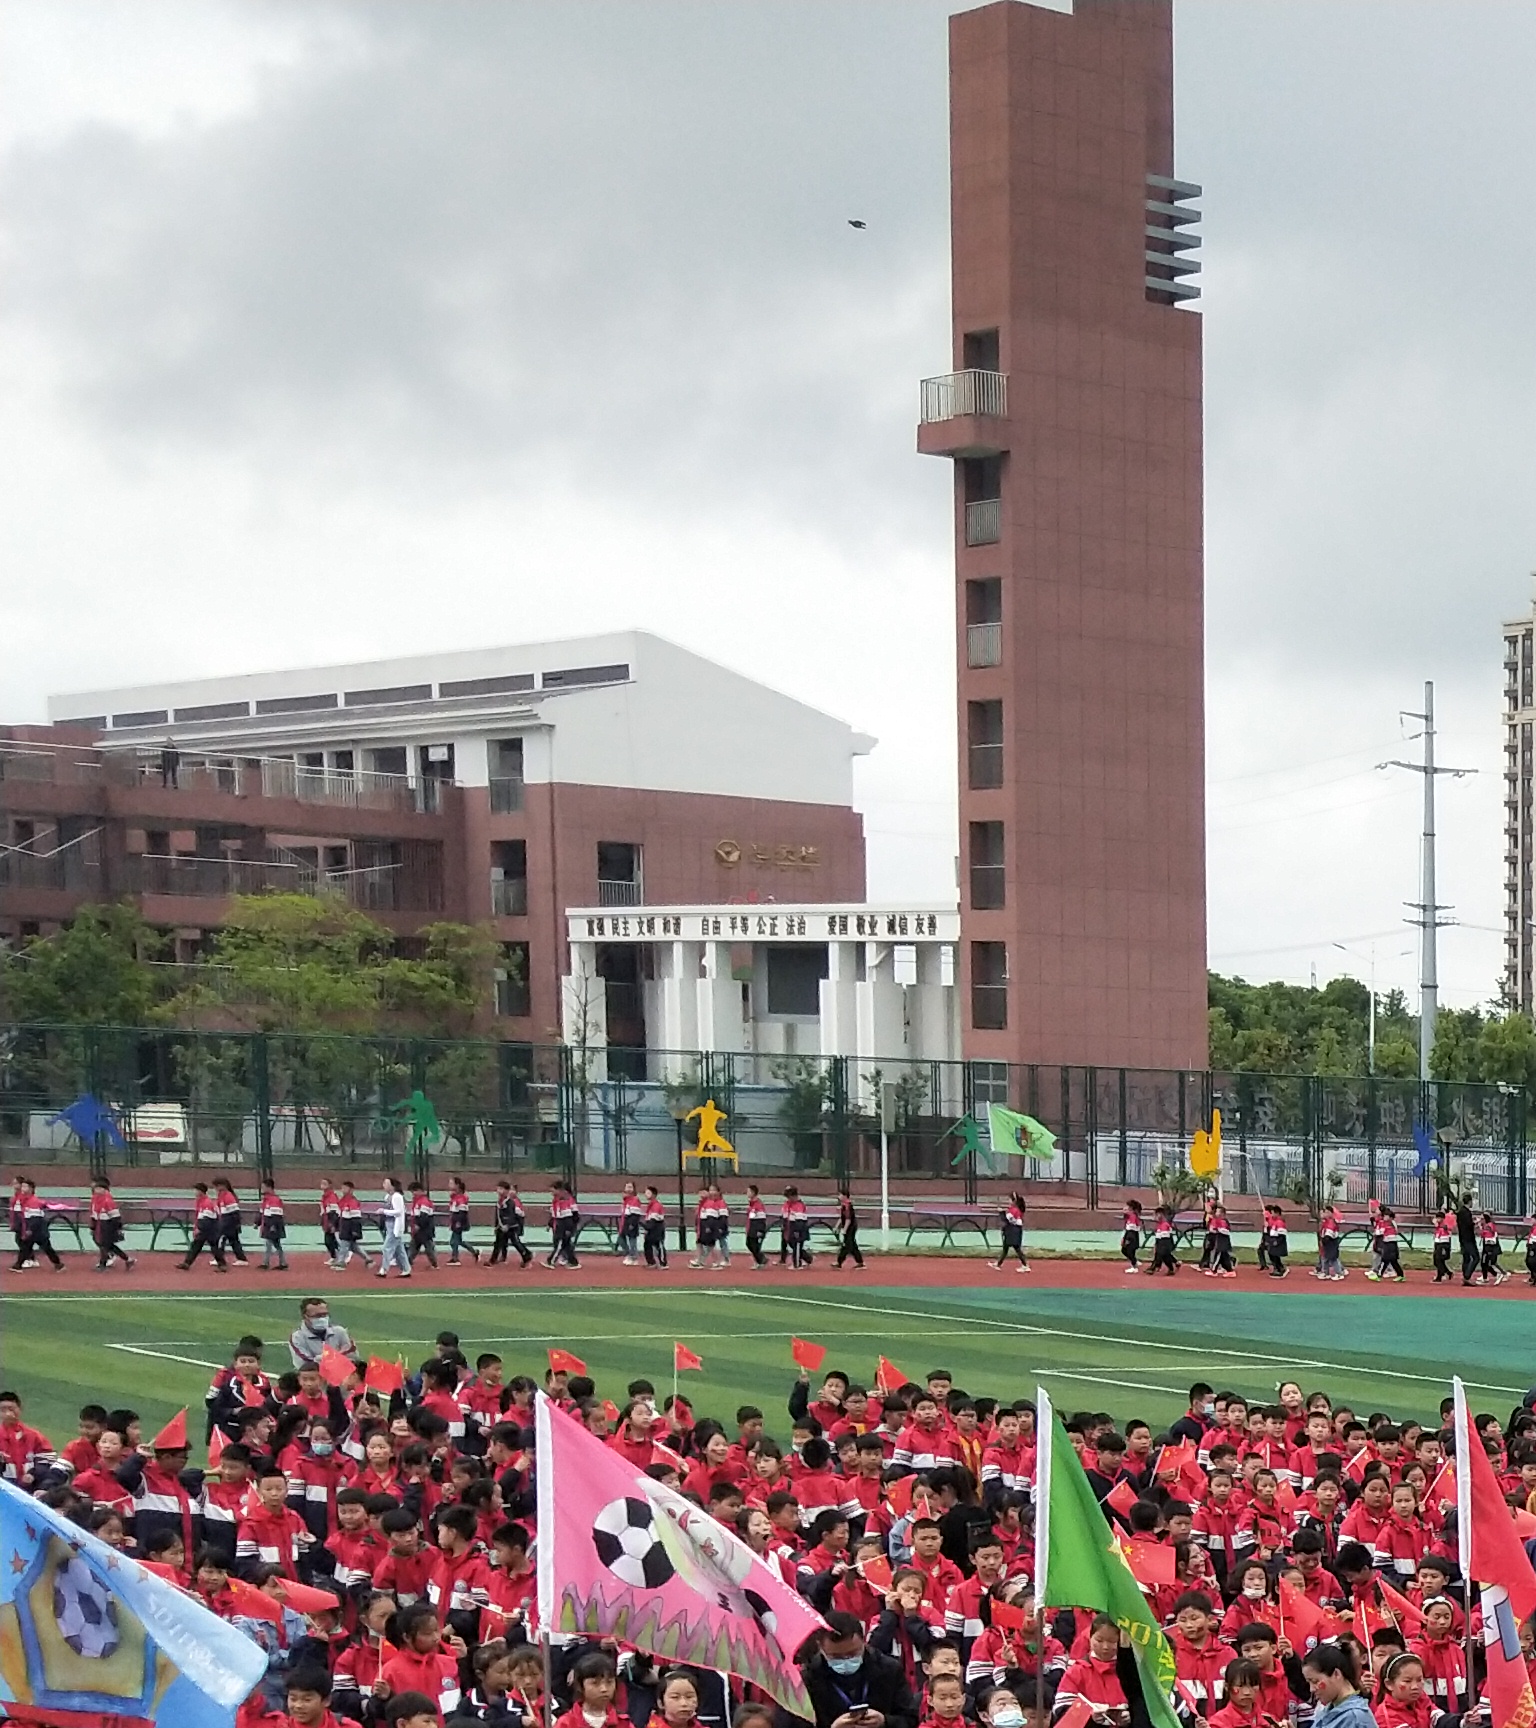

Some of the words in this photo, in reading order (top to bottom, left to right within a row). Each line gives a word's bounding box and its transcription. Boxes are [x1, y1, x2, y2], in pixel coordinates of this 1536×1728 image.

[586, 916, 606, 937] 富强
[611, 916, 631, 937] 民主
[636, 916, 656, 937] 文明
[662, 915, 682, 936] 和谐
[701, 915, 722, 936] 自由
[729, 915, 750, 935] 平等
[756, 915, 779, 936] 公正
[785, 915, 807, 936] 法治
[827, 914, 849, 936] 爱国
[856, 914, 878, 936] 敬业
[886, 914, 908, 936] 诚信
[915, 914, 937, 936] 友善
